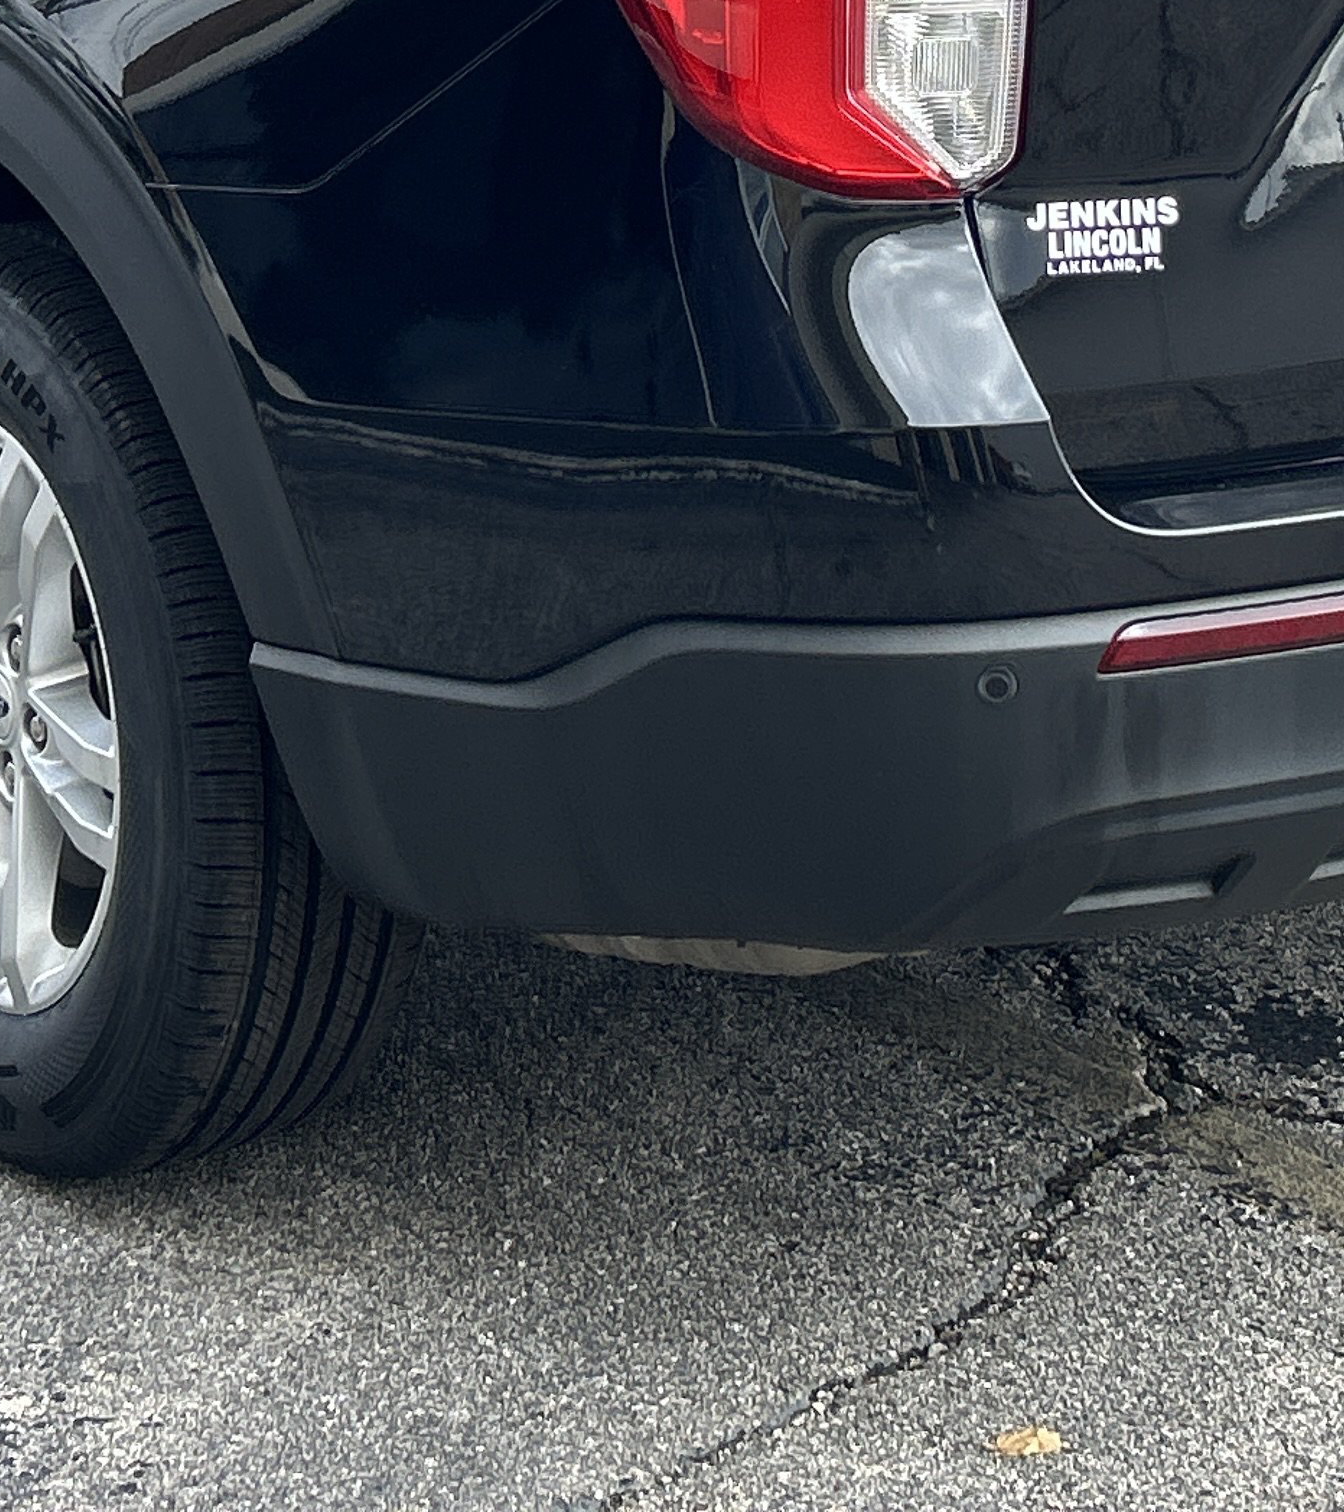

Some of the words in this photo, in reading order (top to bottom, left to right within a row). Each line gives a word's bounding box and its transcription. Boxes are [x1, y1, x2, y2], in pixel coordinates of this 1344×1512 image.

[1026, 196, 1180, 231] JENKINS
[1047, 227, 1162, 259] LINCOLN
[1046, 257, 1142, 275] LAKELAND,
[1144, 256, 1165, 271] FL
[0, 358, 65, 453] HPX
